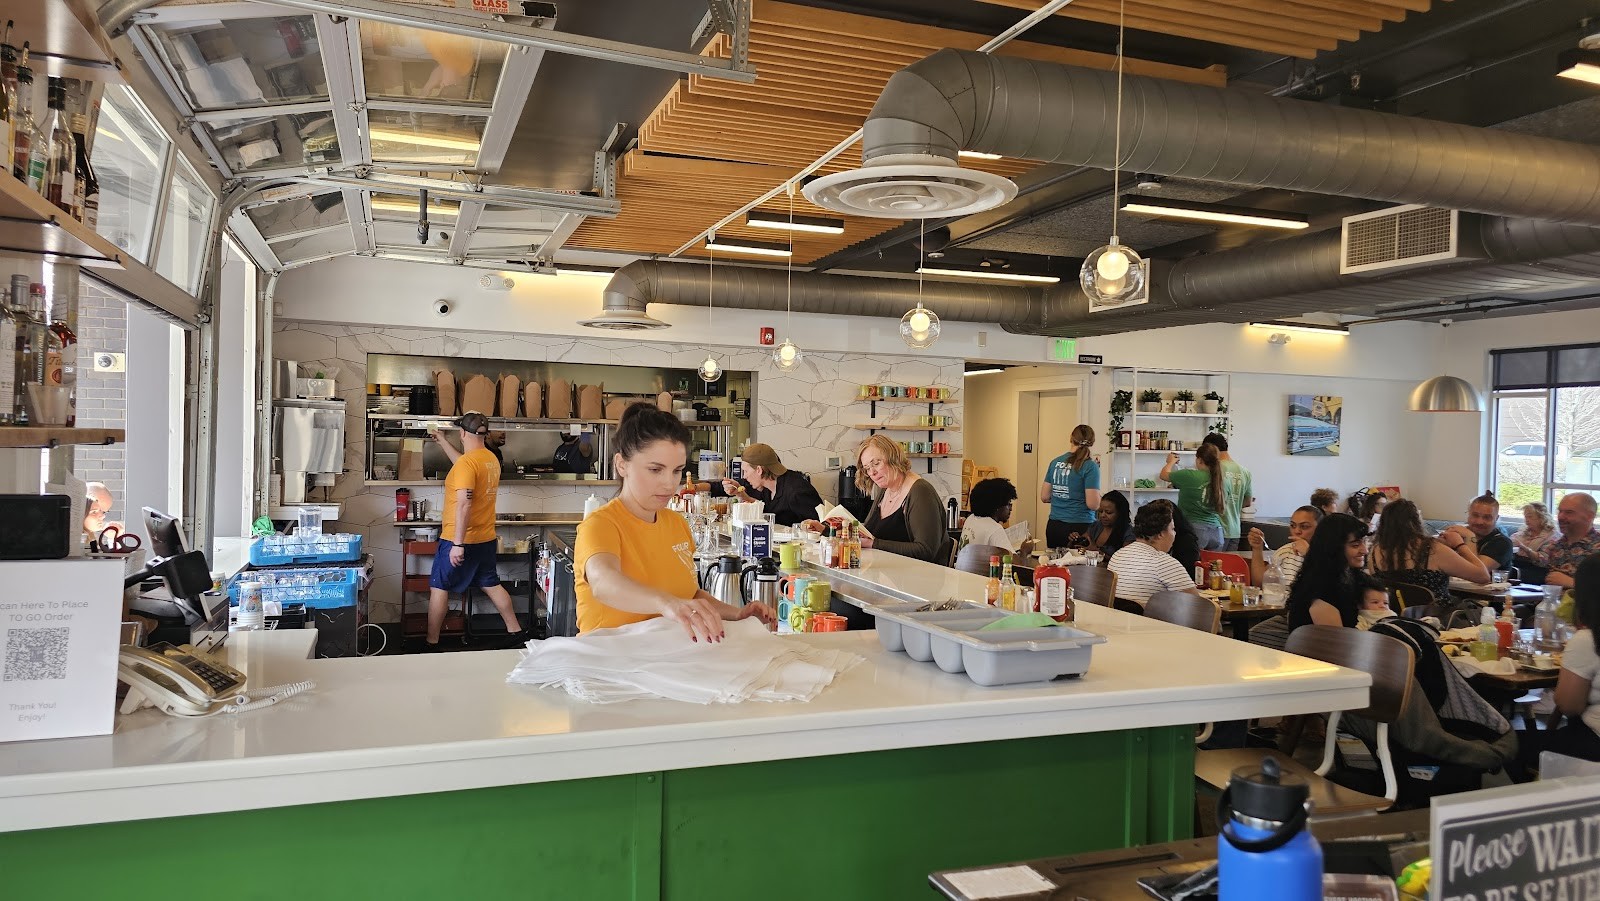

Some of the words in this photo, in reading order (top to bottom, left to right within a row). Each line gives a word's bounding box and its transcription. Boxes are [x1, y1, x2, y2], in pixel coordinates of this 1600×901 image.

[47, 601, 60, 609] To
[62, 600, 89, 608] Place
[8, 613, 23, 622] TO
[26, 613, 42, 622] GO
[44, 612, 73, 621] Order
[8, 702, 36, 711] Thank
[38, 701, 57, 709] You!
[18, 713, 46, 722] Enjoy!
[1448, 827, 1528, 884] Please
